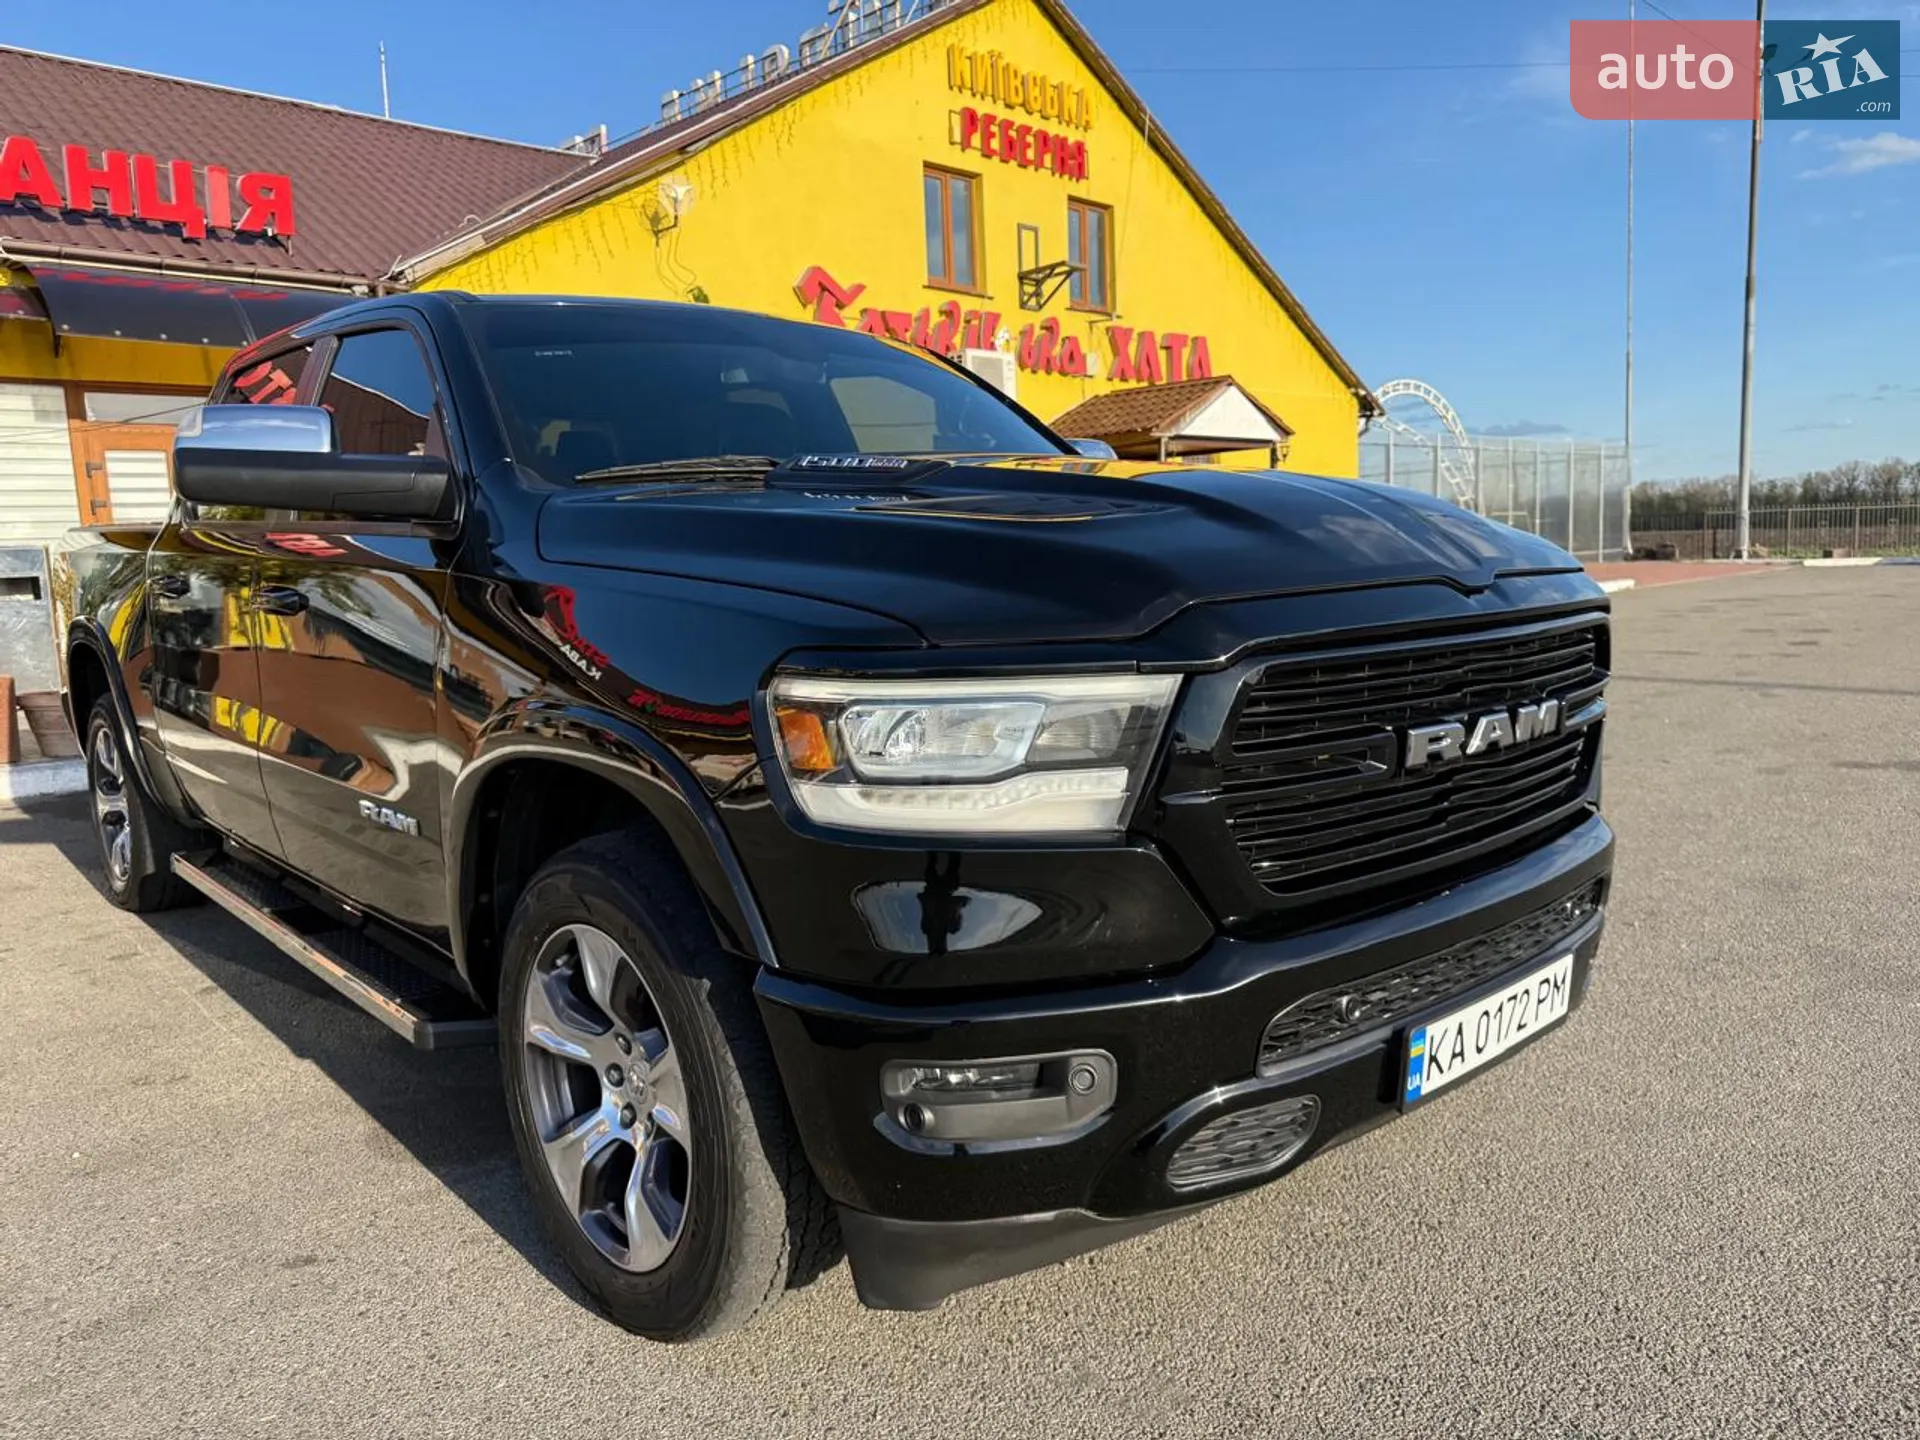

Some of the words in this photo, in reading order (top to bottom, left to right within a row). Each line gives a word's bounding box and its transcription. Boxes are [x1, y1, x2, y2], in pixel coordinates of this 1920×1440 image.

[946, 43, 1094, 131] КИЇВСЬКА
[1106, 325, 1212, 384] ХАТА
[1405, 698, 1559, 769] RAM
[359, 799, 420, 837] RAM
[1425, 1022, 1466, 1083] KA
[1475, 988, 1530, 1056] 0172
[1534, 966, 1569, 1023] PM
